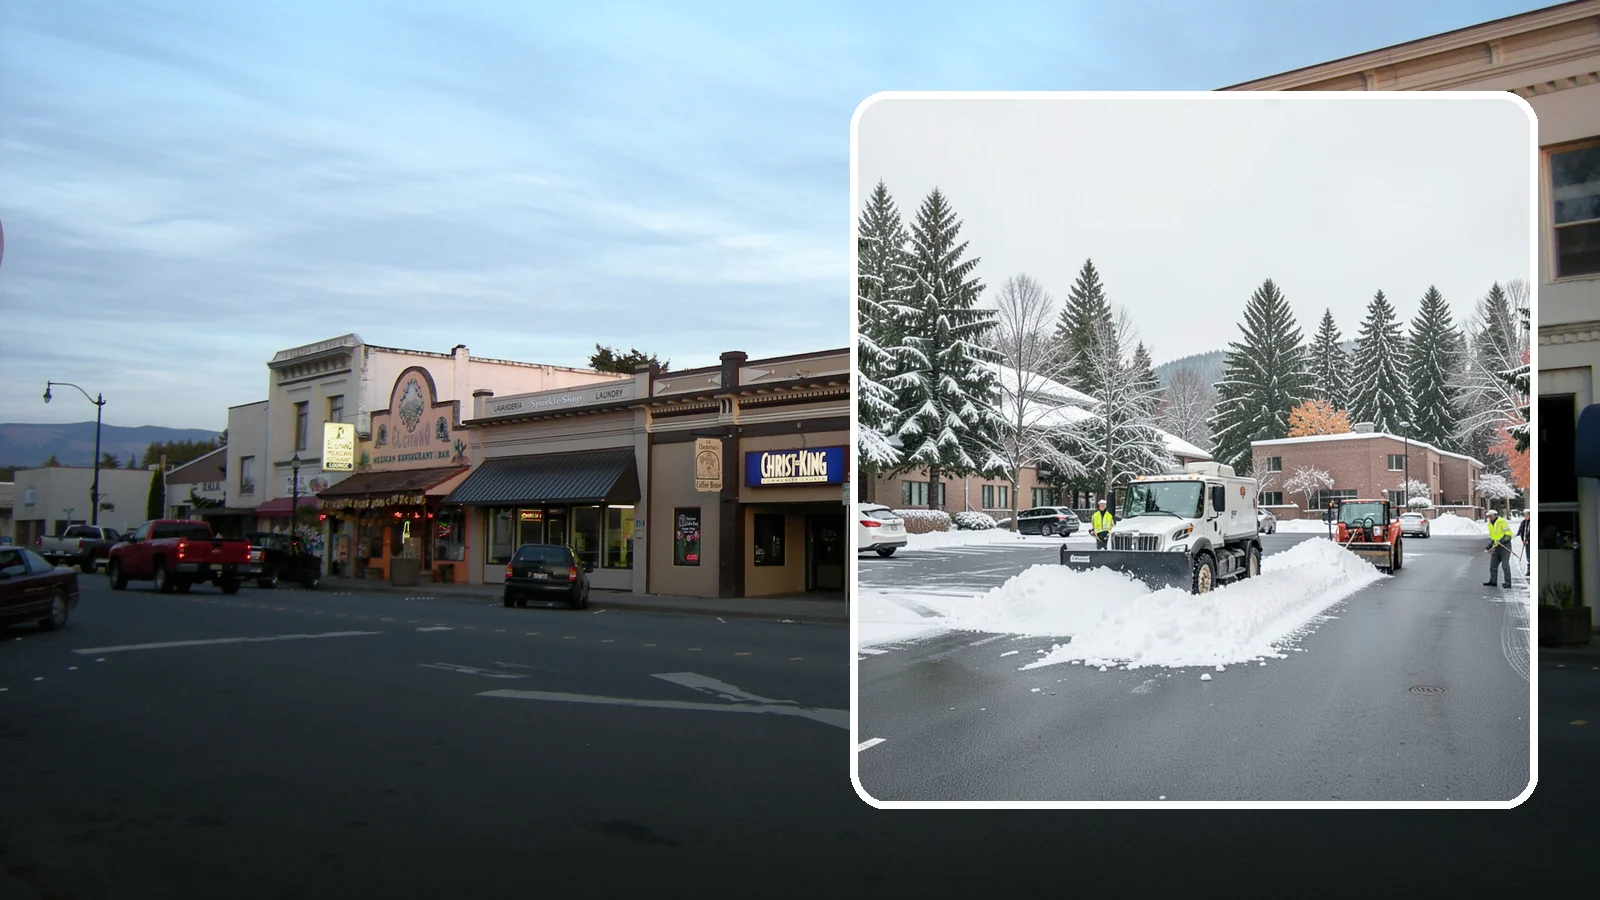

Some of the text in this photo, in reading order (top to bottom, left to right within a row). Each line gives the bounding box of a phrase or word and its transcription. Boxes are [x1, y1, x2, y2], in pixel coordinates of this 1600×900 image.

[595, 389, 624, 400] LAUNDRY
[493, 402, 522, 412] LAVANDERIA
[373, 450, 450, 464] MEXICAN RESTAURANT BAR
[761, 450, 827, 478] CHRIST KING
